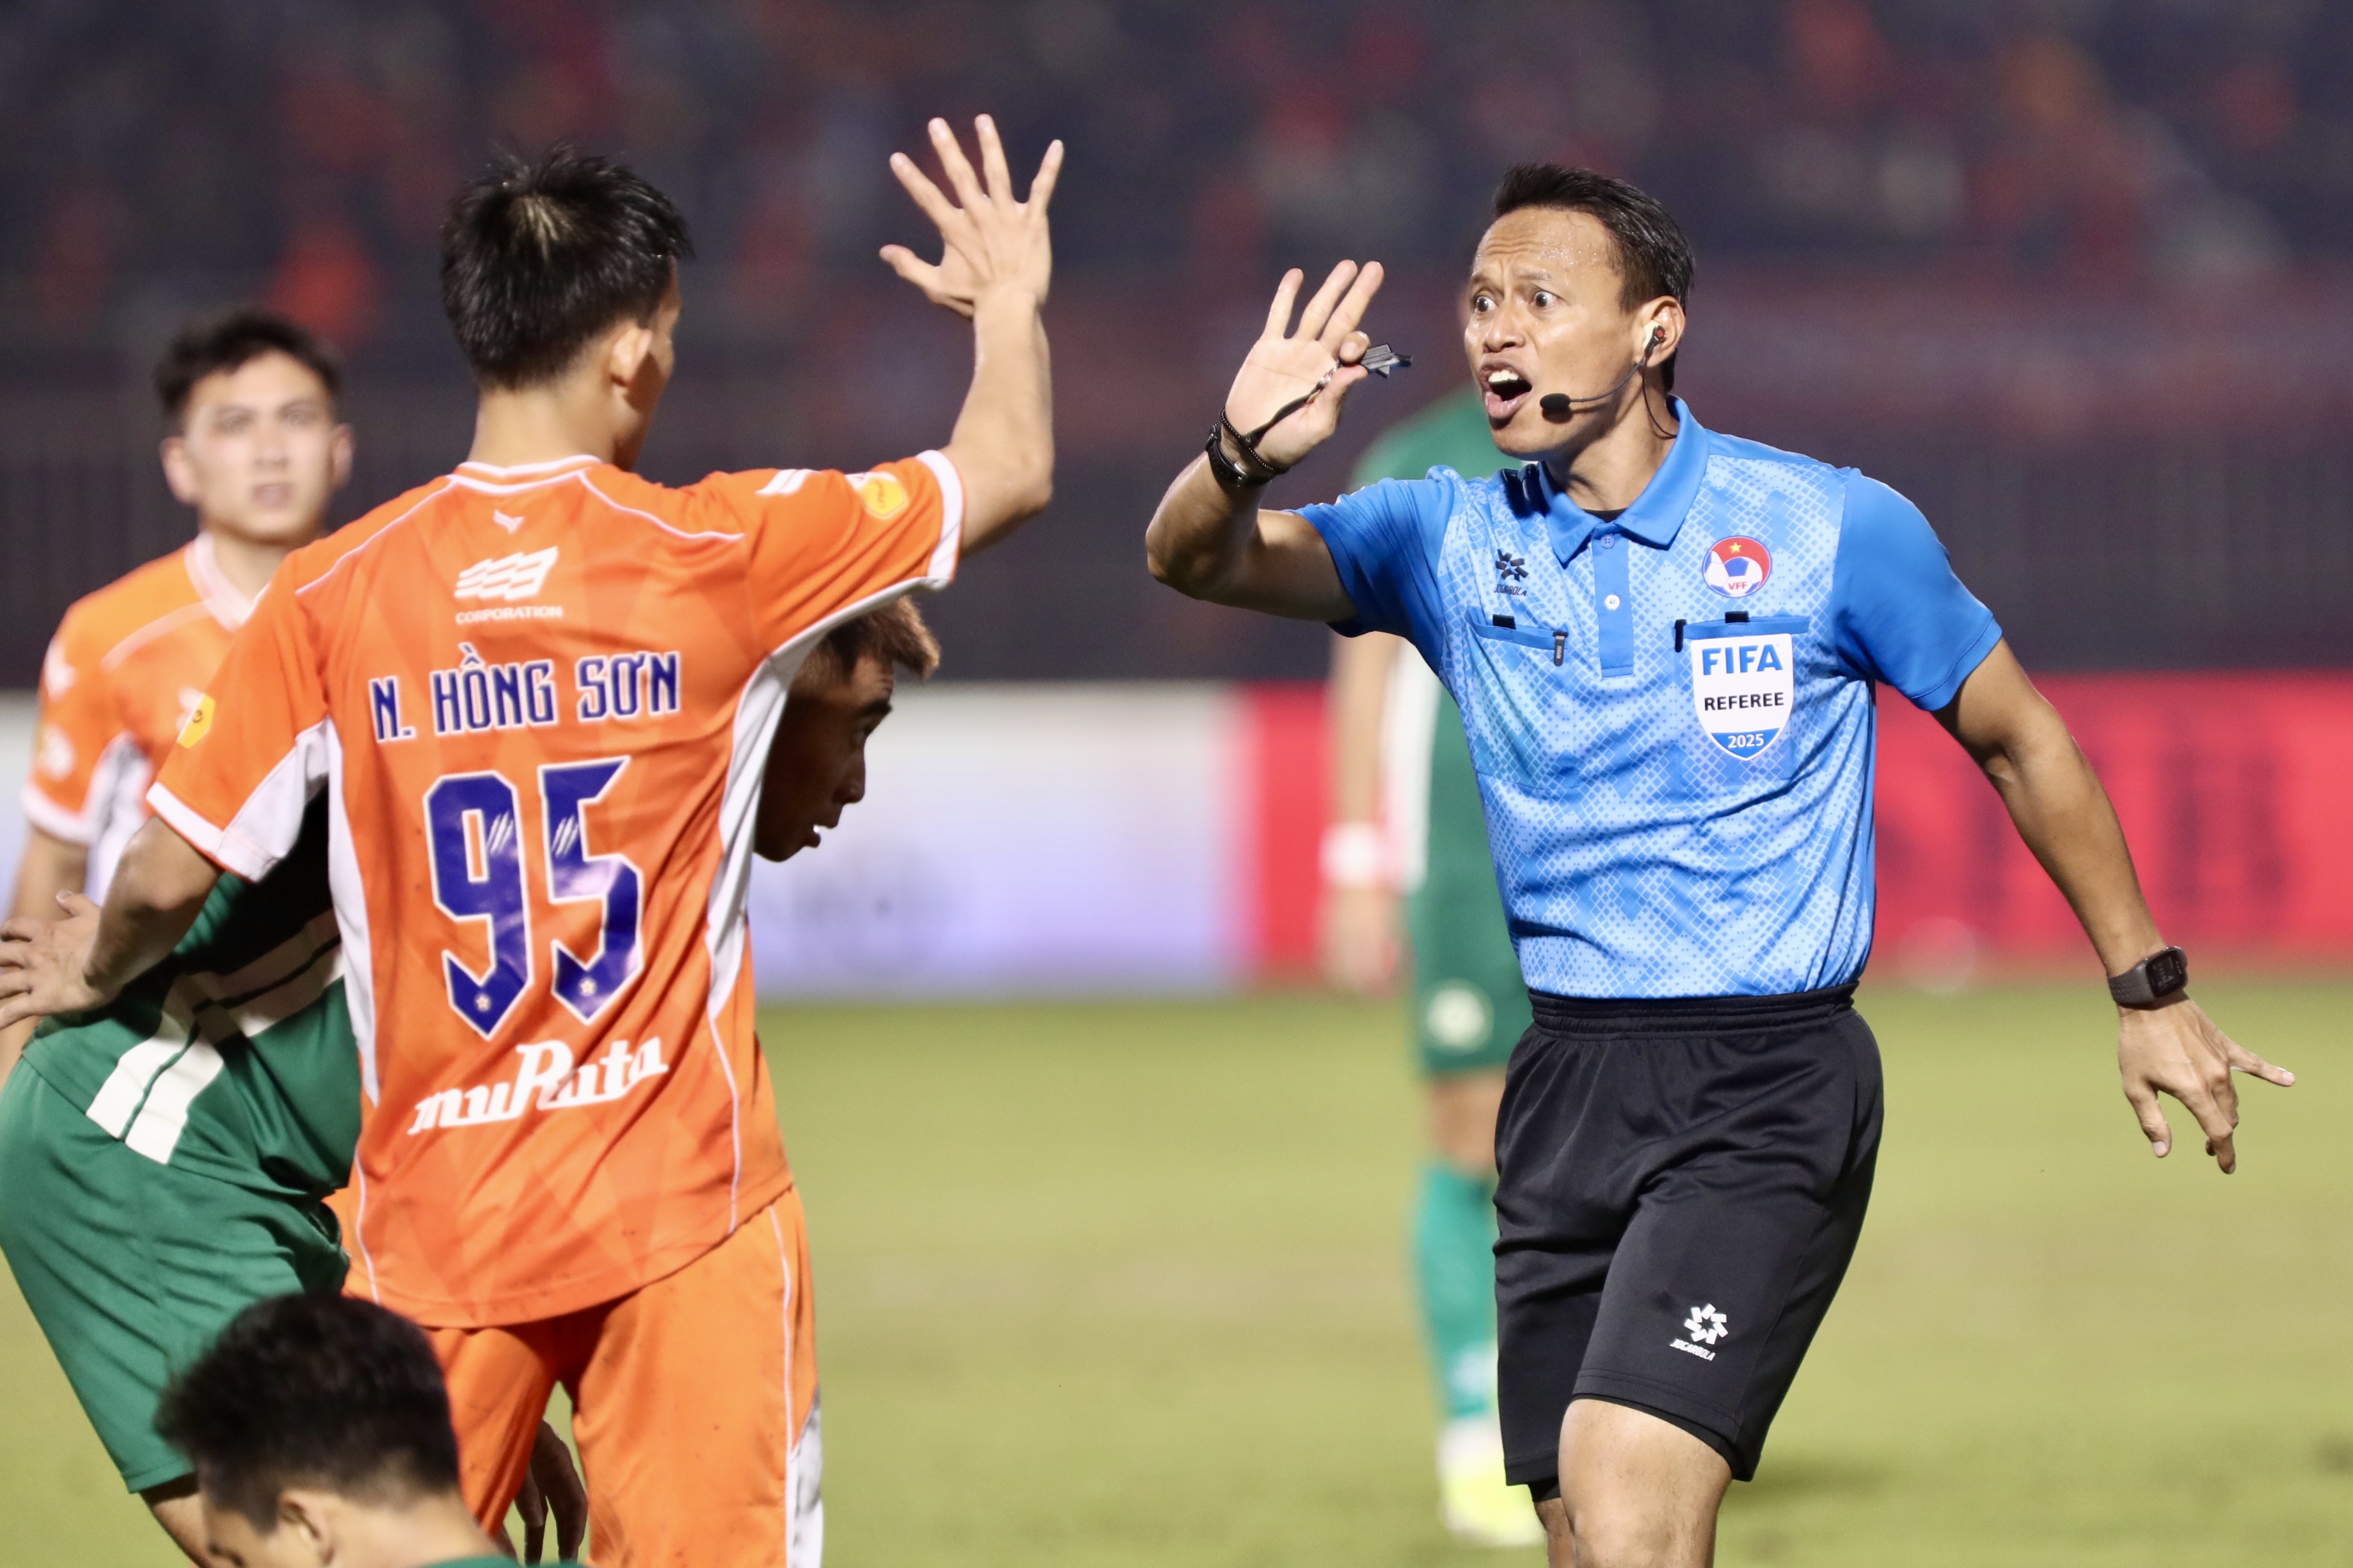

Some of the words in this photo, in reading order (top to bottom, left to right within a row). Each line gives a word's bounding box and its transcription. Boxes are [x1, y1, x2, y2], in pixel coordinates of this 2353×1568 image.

[1727, 581, 1748, 590] VFF
[455, 605, 564, 625] CORPORATION
[1702, 644, 1783, 675] FIFA
[370, 676, 416, 743] N.
[430, 641, 559, 737] HỒNG
[576, 650, 681, 722] SƠN
[1704, 692, 1784, 711] REFEREE
[1727, 733, 1764, 749] 2025
[422, 756, 645, 1041] 95
